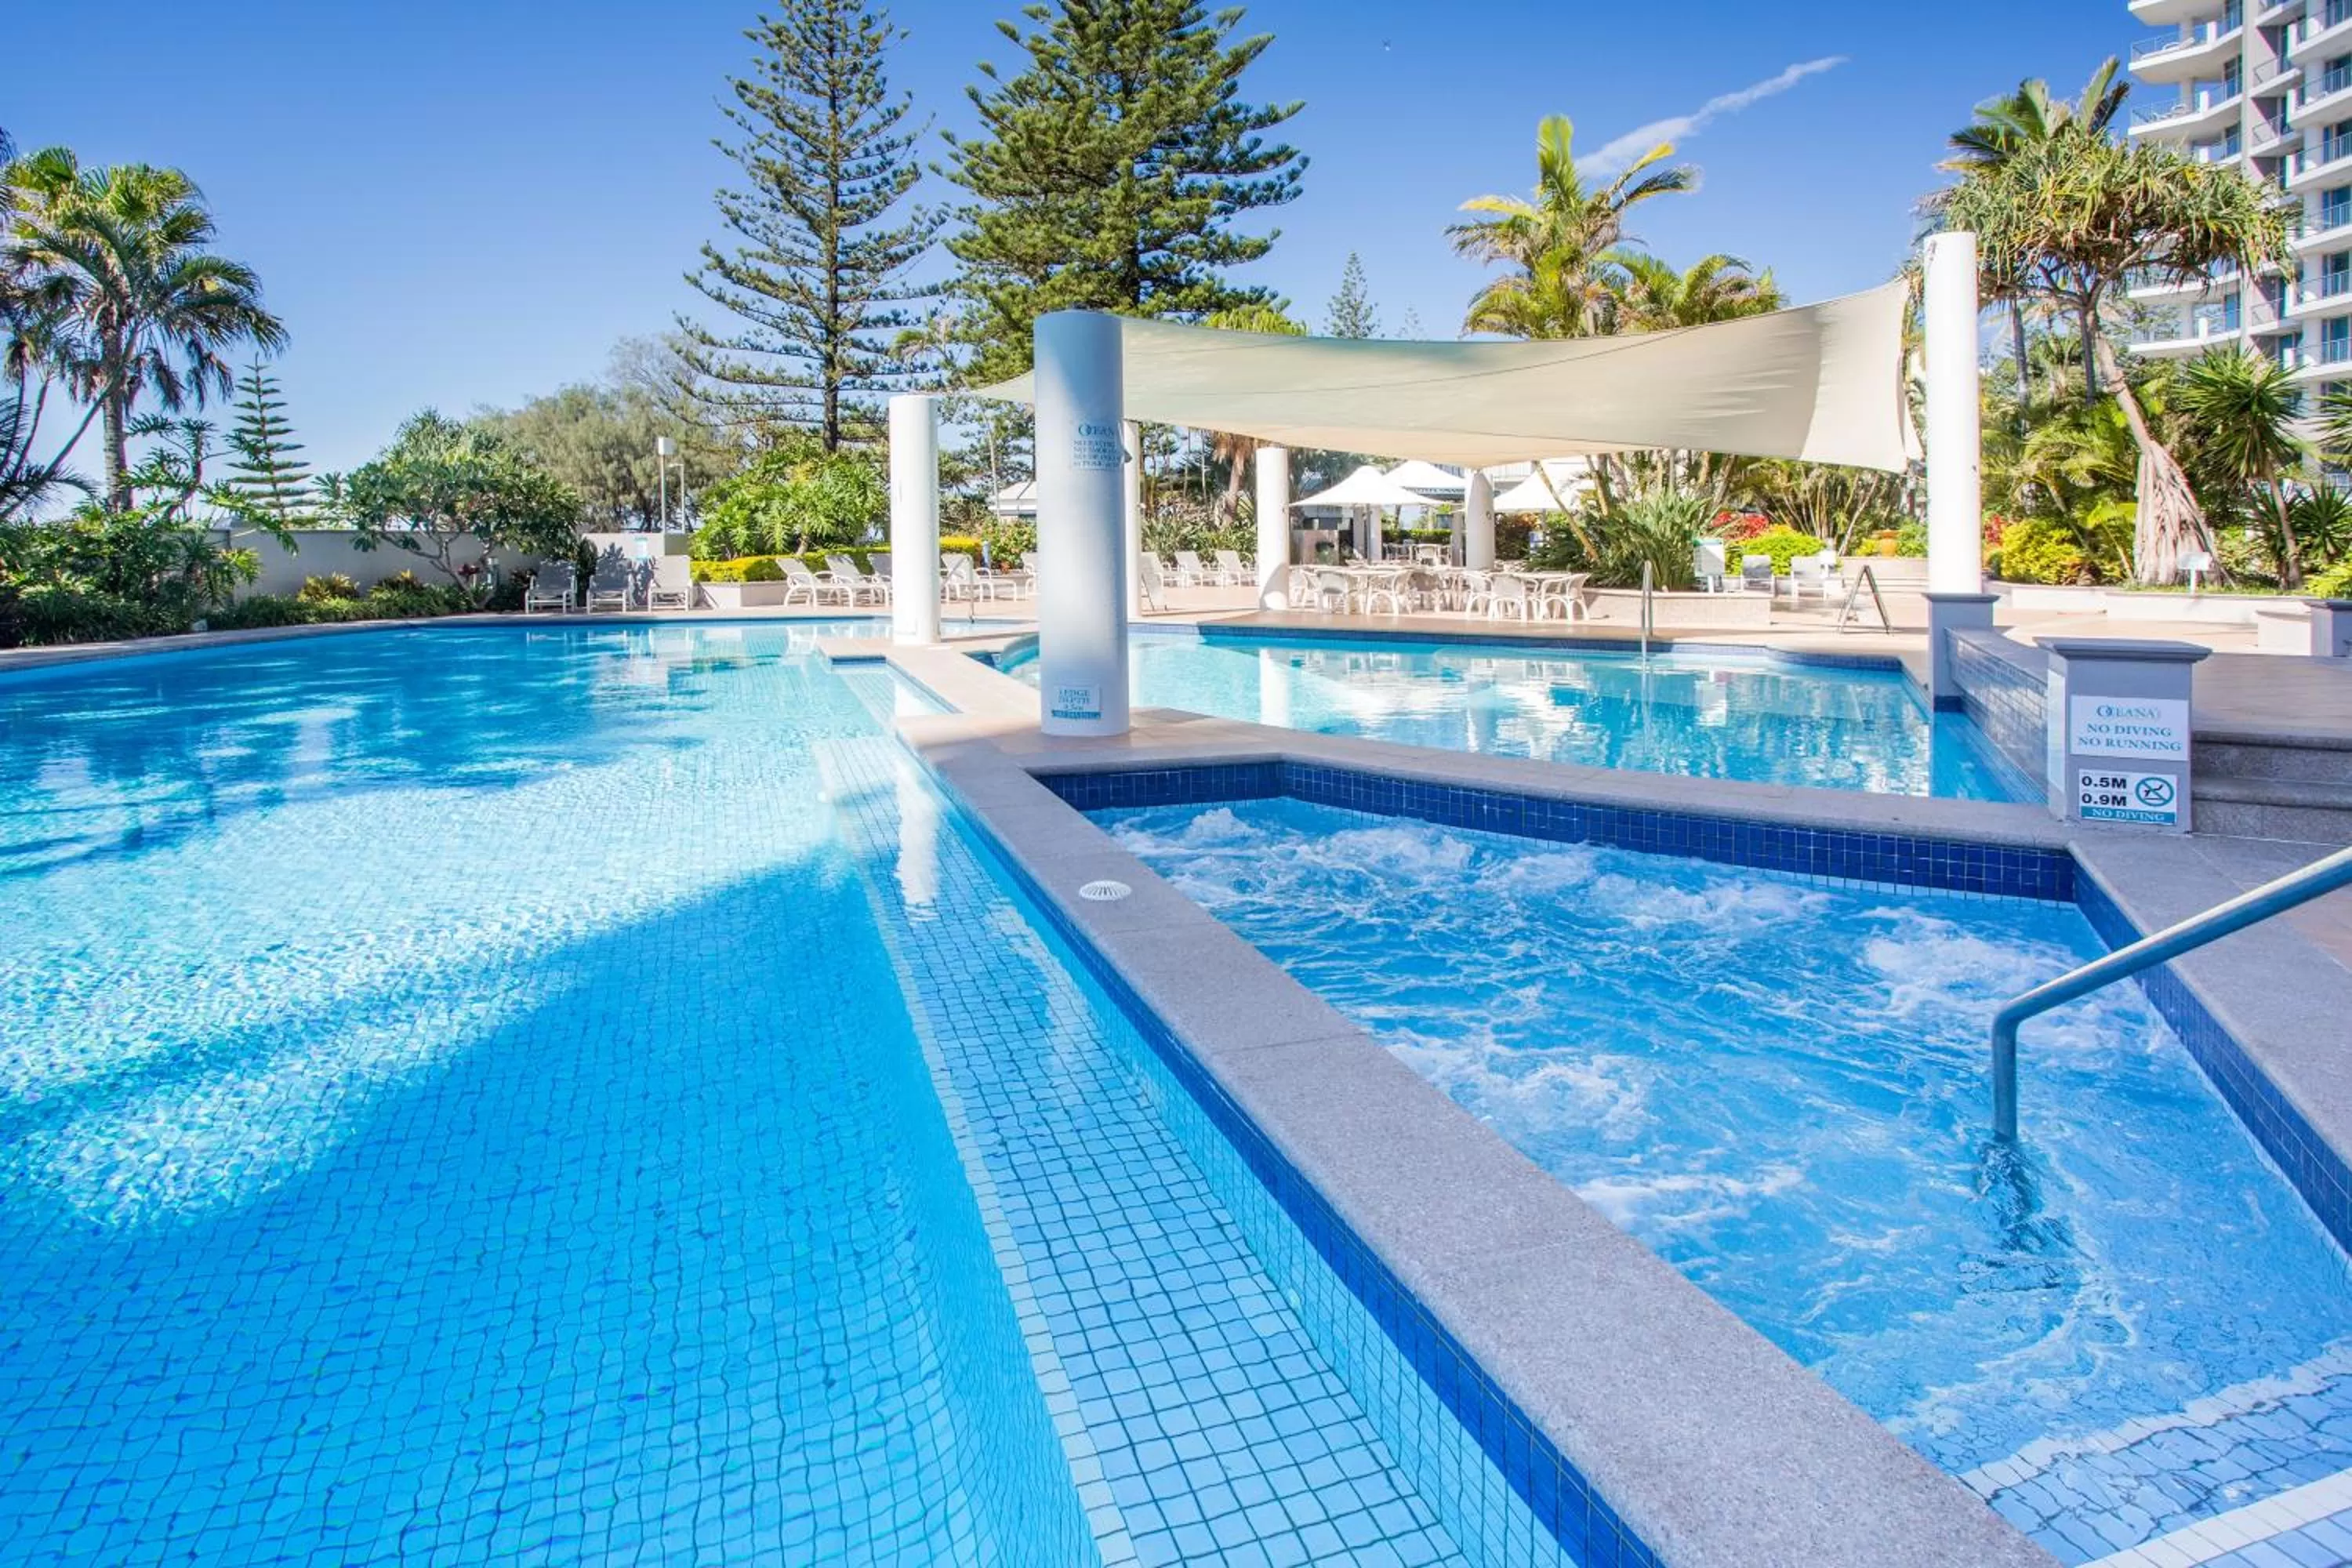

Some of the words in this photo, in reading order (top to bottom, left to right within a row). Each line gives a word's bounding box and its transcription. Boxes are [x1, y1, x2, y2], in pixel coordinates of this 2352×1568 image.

[2087, 723, 2110, 734] NO
[2114, 724, 2171, 737] DIVING
[2079, 737, 2100, 746] NO
[2106, 737, 2181, 751] RUNNING
[2082, 775, 2127, 789] 0.5M
[2082, 793, 2127, 807] 0.9M
[2092, 808, 2112, 817] NO
[2117, 810, 2165, 821] DIVING
